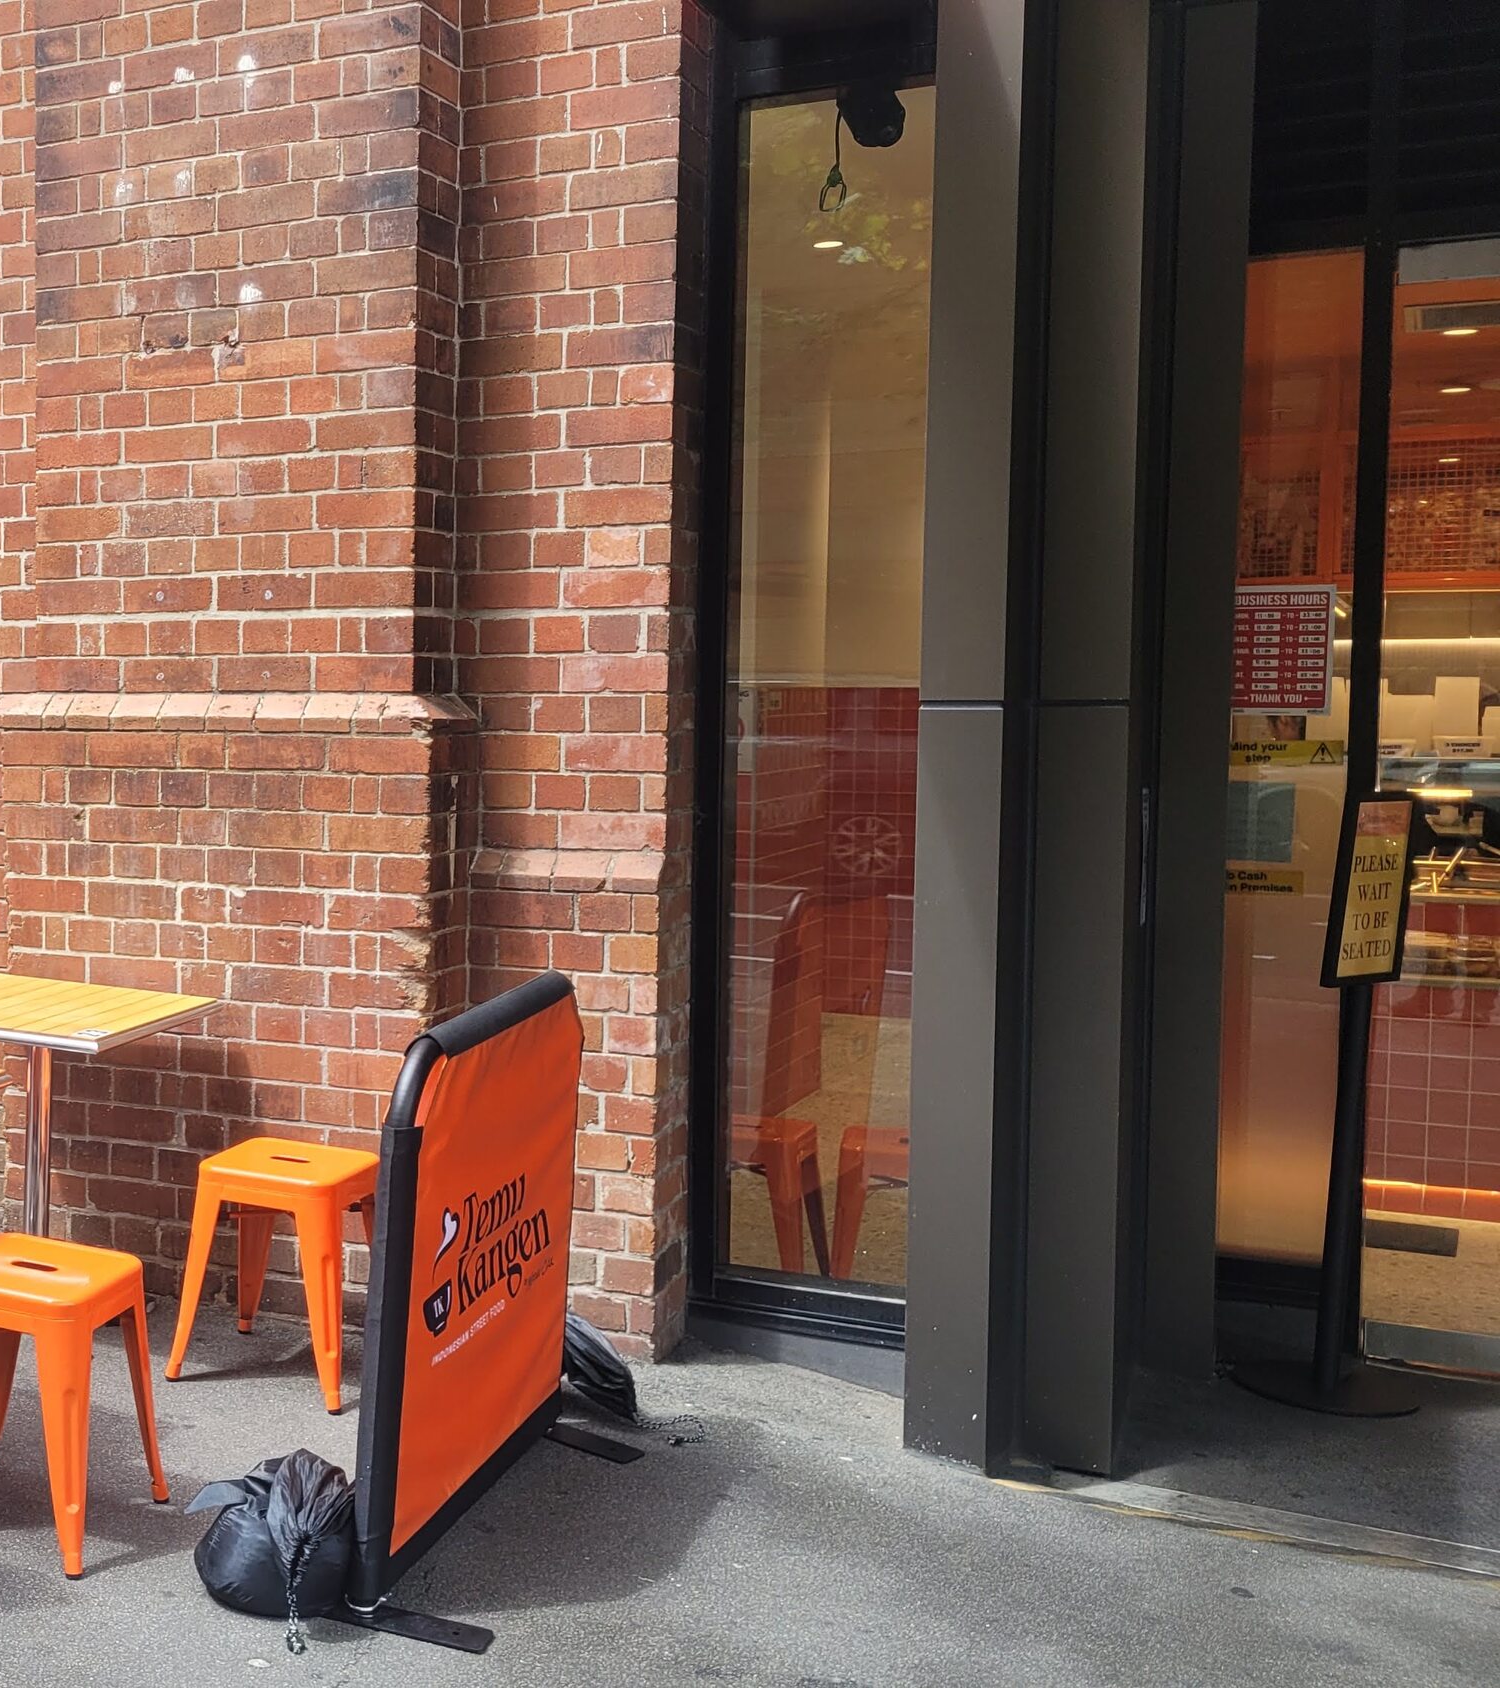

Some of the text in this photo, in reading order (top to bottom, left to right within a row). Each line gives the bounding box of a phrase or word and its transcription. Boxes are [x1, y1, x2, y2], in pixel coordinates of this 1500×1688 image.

[1235, 593, 1328, 606] BUSINESS HOURS
[1250, 694, 1302, 703] THANK YOU
[1261, 743, 1287, 753] your
[1353, 853, 1399, 873] PLEASE
[1237, 870, 1267, 880] Cash
[1240, 883, 1293, 892] Premises
[1357, 882, 1392, 901] WAIT
[1352, 911, 1389, 931] TO BE
[1341, 938, 1391, 960] SEATED
[461, 1172, 526, 1254] Temu
[457, 1208, 551, 1316] Kangen
[433, 1295, 445, 1318] TK
[431, 1299, 506, 1368] INDONESIAN STREET FOOD
